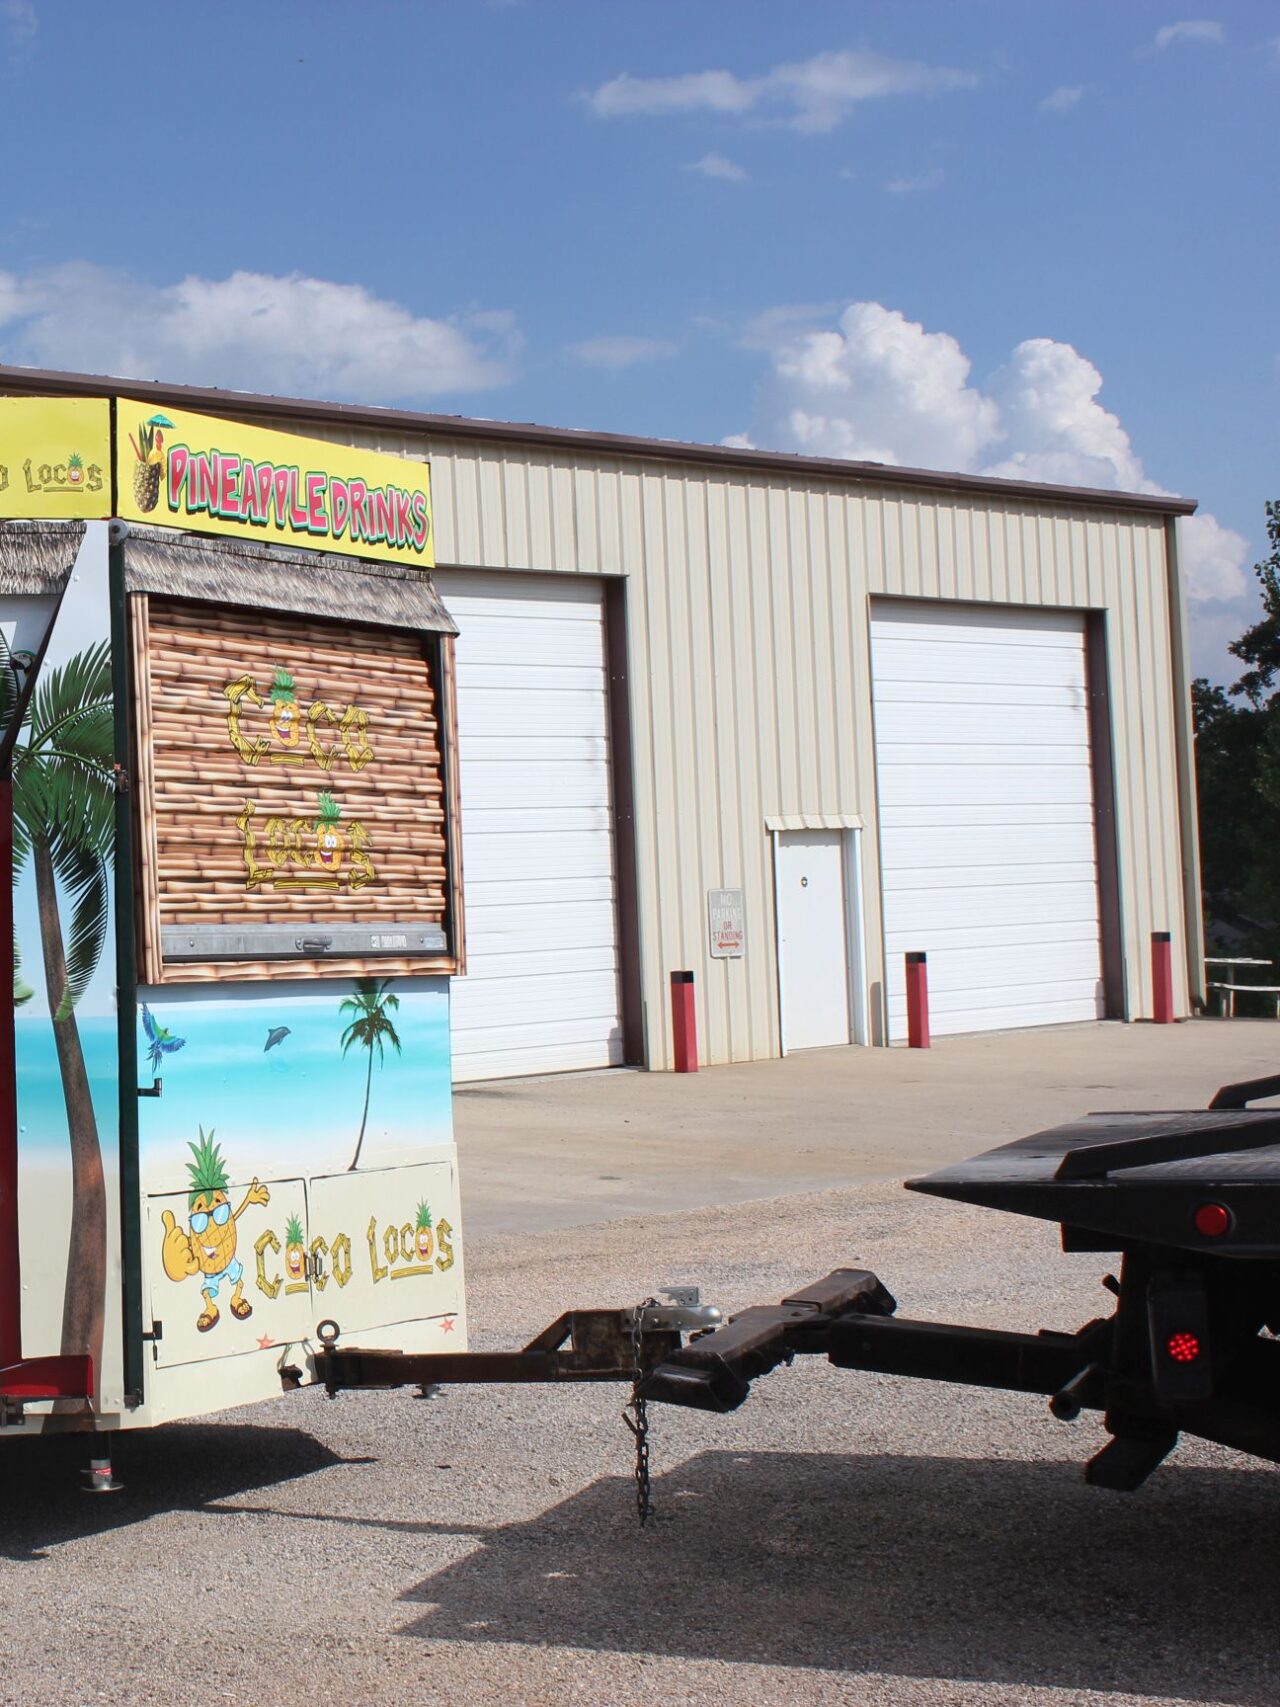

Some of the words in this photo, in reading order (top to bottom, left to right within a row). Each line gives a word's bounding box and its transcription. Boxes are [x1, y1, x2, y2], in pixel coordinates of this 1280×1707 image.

[167, 443, 329, 536] PINEAPPLE
[329, 476, 431, 554] DRINKS
[720, 892, 733, 906] NO
[723, 921, 733, 931] OR
[712, 931, 743, 942] STANDING
